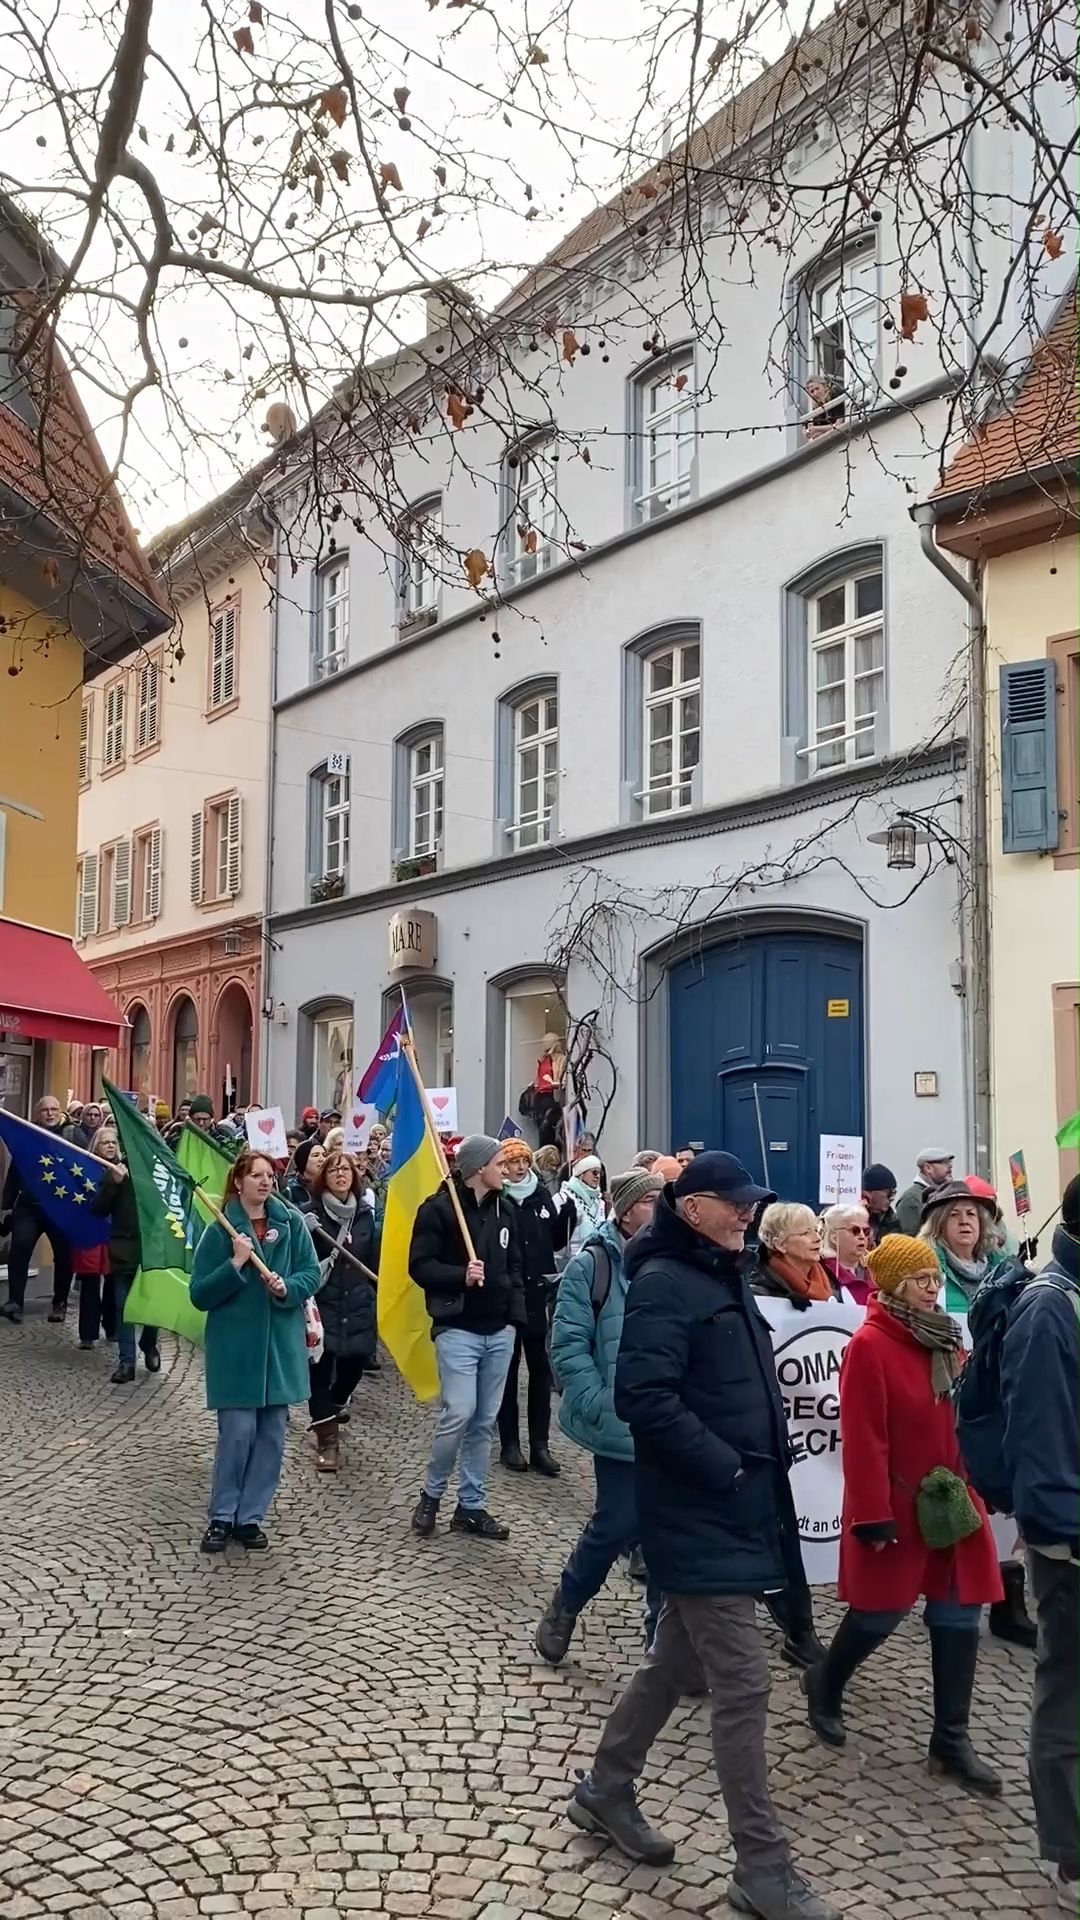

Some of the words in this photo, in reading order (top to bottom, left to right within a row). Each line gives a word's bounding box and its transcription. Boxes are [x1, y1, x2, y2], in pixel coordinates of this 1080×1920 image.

[826, 1150, 855, 1160] Fruen-
[829, 1162, 854, 1172] echte
[825, 1184, 857, 1195] Repekt
[813, 1521, 828, 1532] an
[832, 1515, 843, 1530] d
